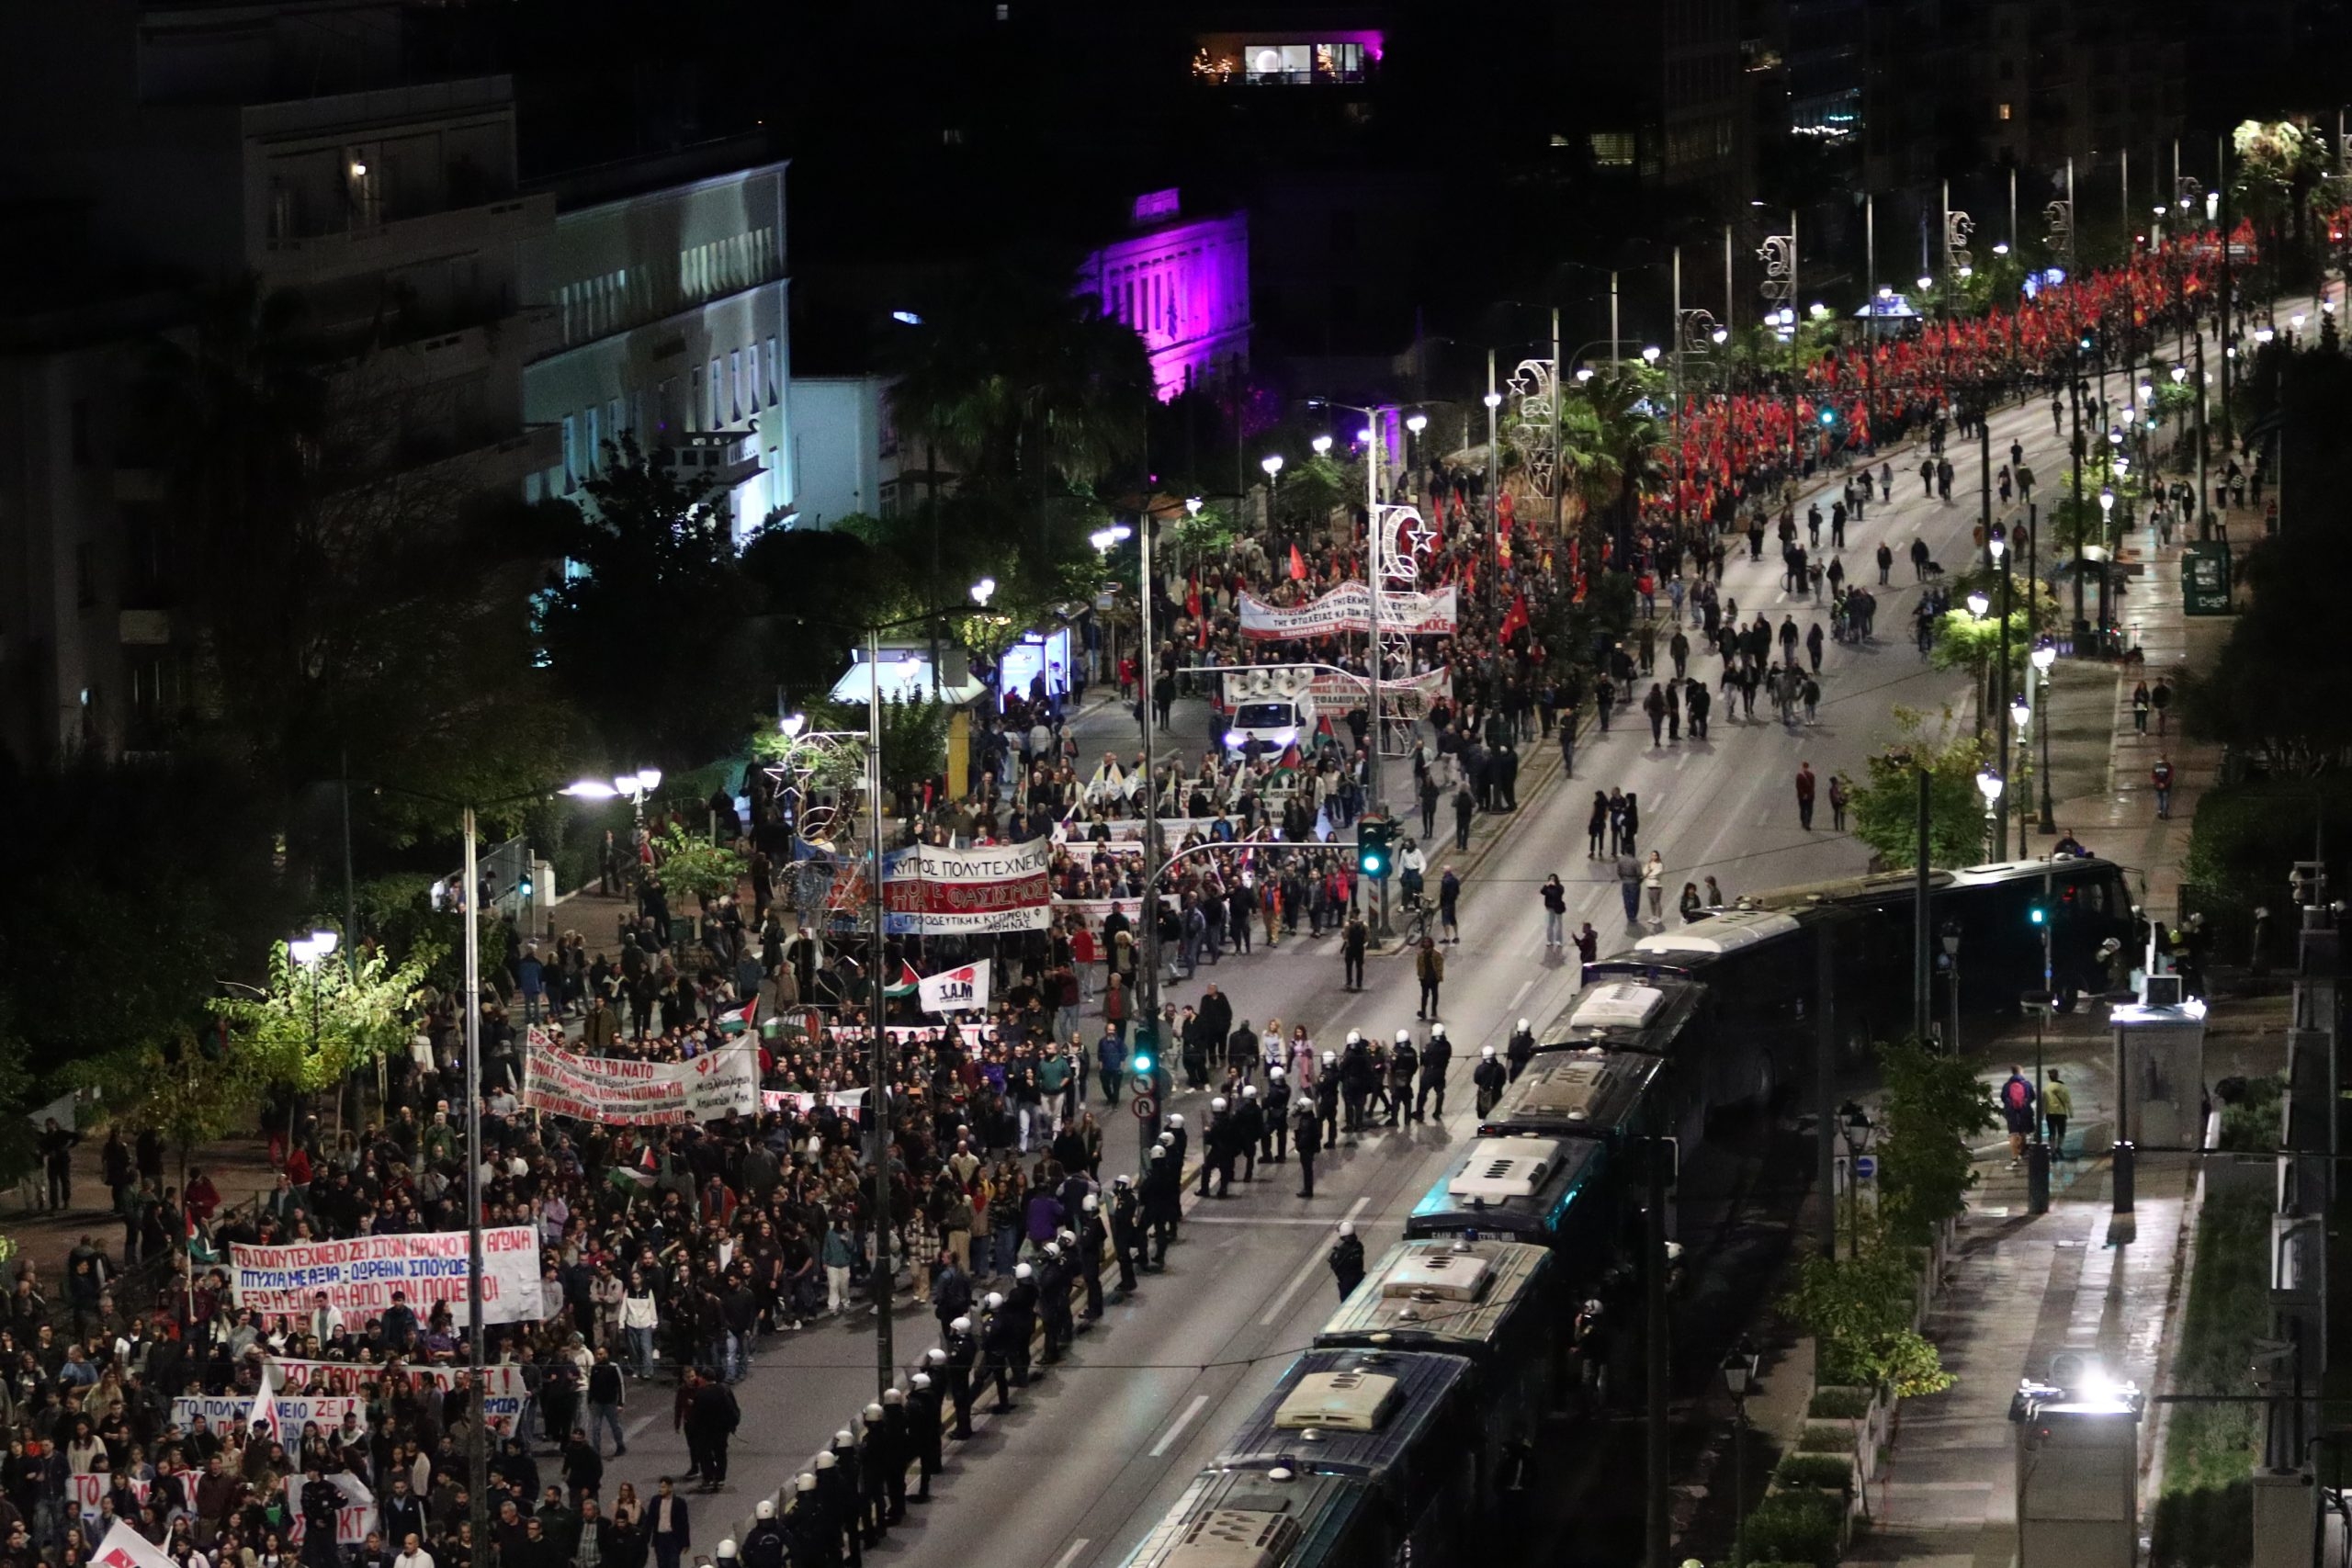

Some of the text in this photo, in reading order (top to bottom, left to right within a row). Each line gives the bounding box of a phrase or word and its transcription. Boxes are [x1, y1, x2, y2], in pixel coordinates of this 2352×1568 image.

[942, 850, 1046, 877] ΠΟΛΥΤΕΧΝΕΙΟ
[947, 878, 1049, 908] ΦΑΣΙΣΜΟΣ
[621, 1061, 653, 1079] ΝΑΤΟ
[349, 1241, 369, 1261] ΖΕΙ
[371, 1235, 407, 1258] ΣΤΟΝ
[410, 1235, 458, 1258] ΔΡΟΜΟ
[487, 1229, 531, 1253] ΑΓΩΝΑ
[241, 1269, 286, 1287] ΠΤΥΧΙΑ
[288, 1269, 309, 1287] ΜΕ
[309, 1267, 341, 1284] ΑΞΙΑ
[351, 1259, 404, 1280] ΔΩΡΕΑΝ
[349, 1282, 381, 1306] ΑΠΟ
[178, 1399, 199, 1416] ΤΟ
